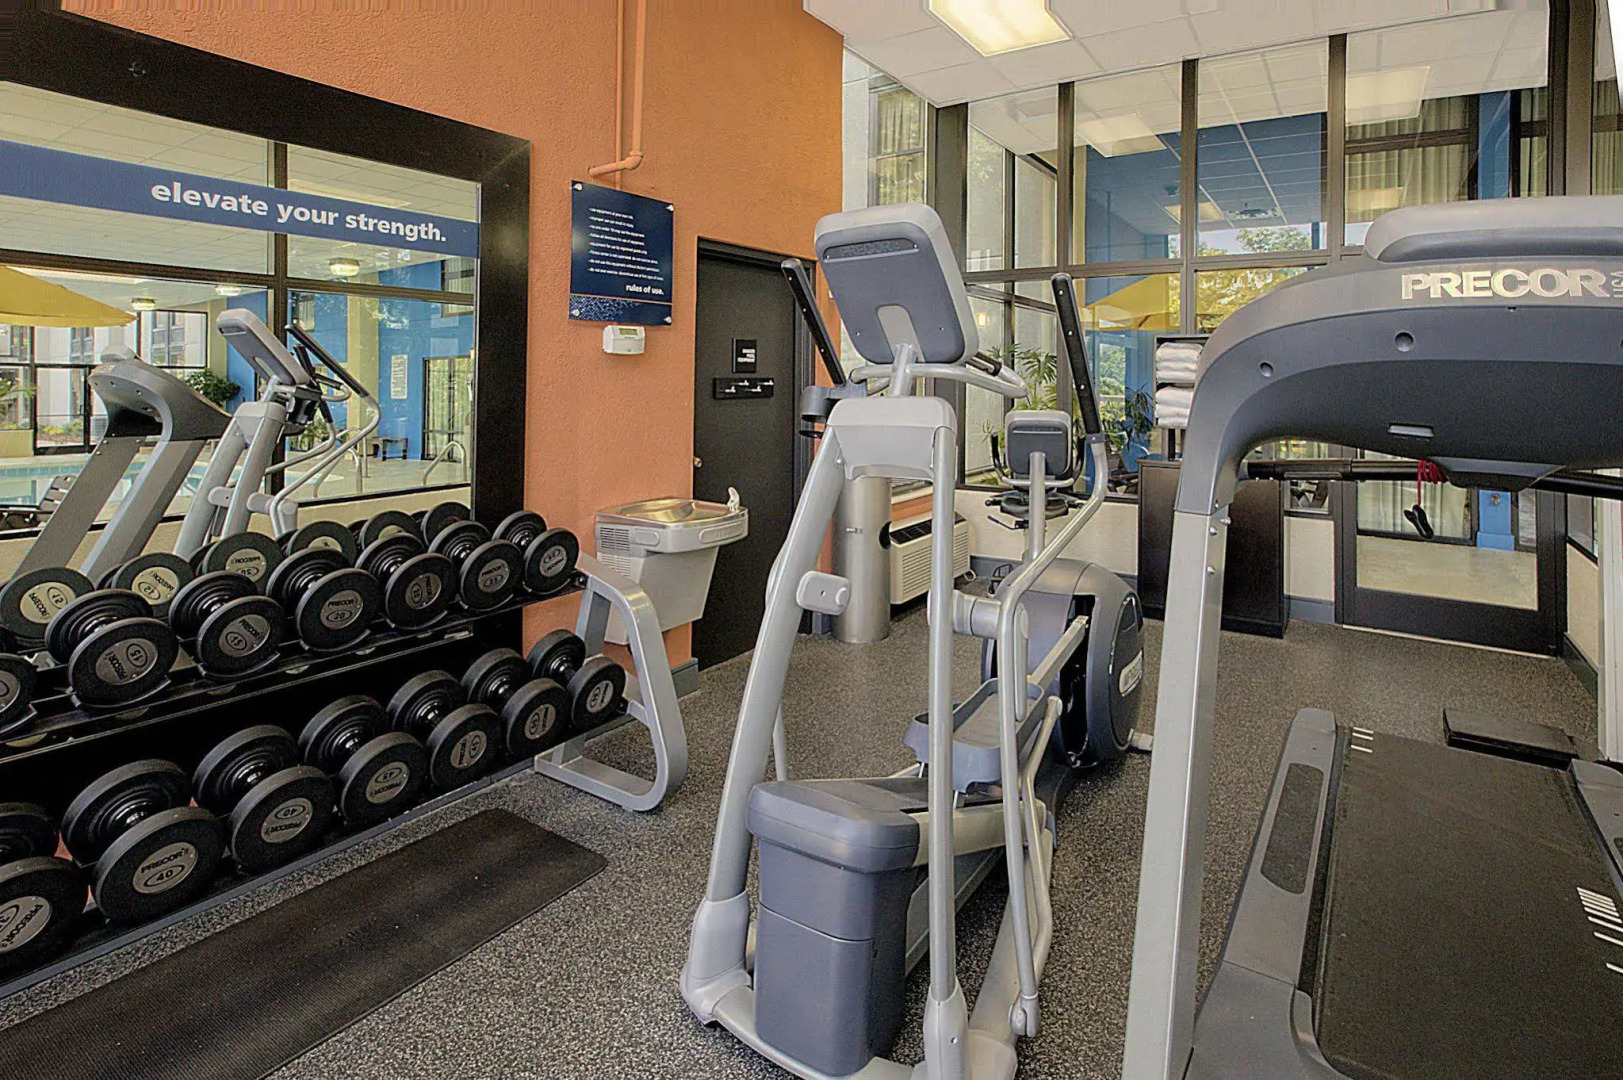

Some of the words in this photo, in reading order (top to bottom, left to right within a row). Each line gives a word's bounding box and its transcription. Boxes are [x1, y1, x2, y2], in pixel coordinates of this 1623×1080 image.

[150, 181, 269, 216] elevate
[276, 203, 339, 226] your
[345, 213, 447, 243] strength.
[626, 284, 642, 293] rules
[643, 286, 651, 294] of
[1401, 268, 1611, 300] PRECOR
[328, 599, 354, 608] PRECOR
[334, 612, 346, 620] 20
[238, 619, 262, 638] PRECOR
[230, 636, 242, 646] 15
[130, 649, 144, 661] 15
[108, 656, 128, 680] PRECOR
[382, 770, 394, 780] 45
[374, 782, 400, 796] PRECOR
[284, 807, 296, 816] 40
[270, 821, 302, 834] PRECOR
[140, 847, 184, 874] PRECOR
[156, 869, 174, 881] 40
[3, 904, 44, 944] PRECOR
